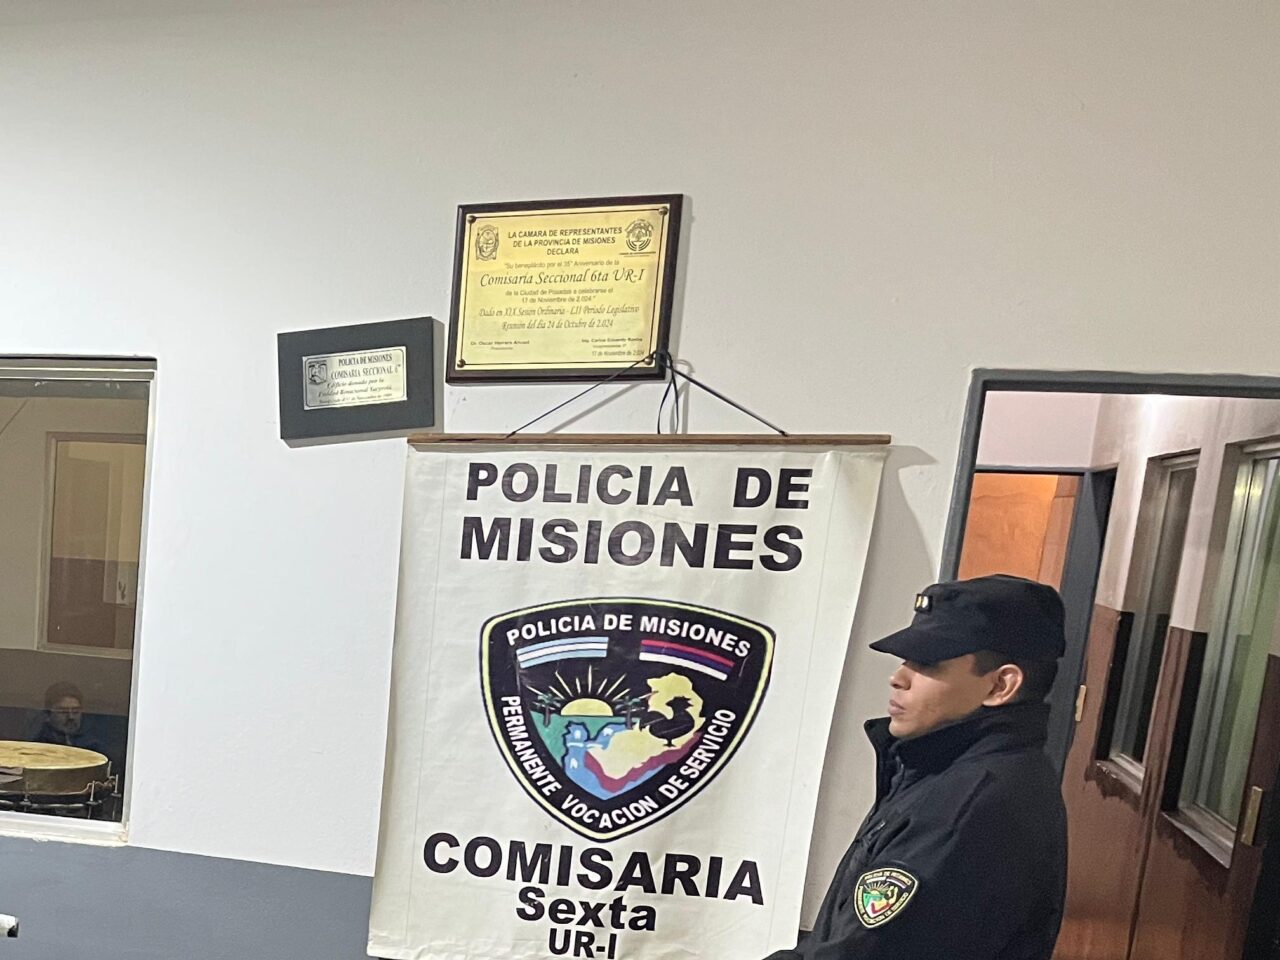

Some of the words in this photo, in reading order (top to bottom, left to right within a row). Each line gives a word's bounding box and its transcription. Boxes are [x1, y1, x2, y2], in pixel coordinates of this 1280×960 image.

[518, 230, 547, 238] CAMARA
[559, 227, 622, 236] REPRESENTANTES
[534, 238, 570, 246] PROVINCIA
[535, 269, 586, 285] Seccional
[591, 270, 608, 282] 6ta
[612, 268, 645, 283] UR-I
[466, 462, 694, 507] POLICIA
[733, 467, 814, 510] DE
[459, 516, 804, 573] MISIONES
[506, 615, 596, 646] POLICIA
[603, 614, 633, 631] DE
[639, 615, 751, 658] MISIONES
[501, 695, 562, 797] PERMANENTE
[560, 793, 659, 829] VOCACION
[658, 774, 690, 799] DE
[679, 709, 737, 778] SERVICIO
[422, 832, 765, 906] COMISARIA
[515, 886, 657, 932] Sexta
[547, 927, 618, 960] UR-I
